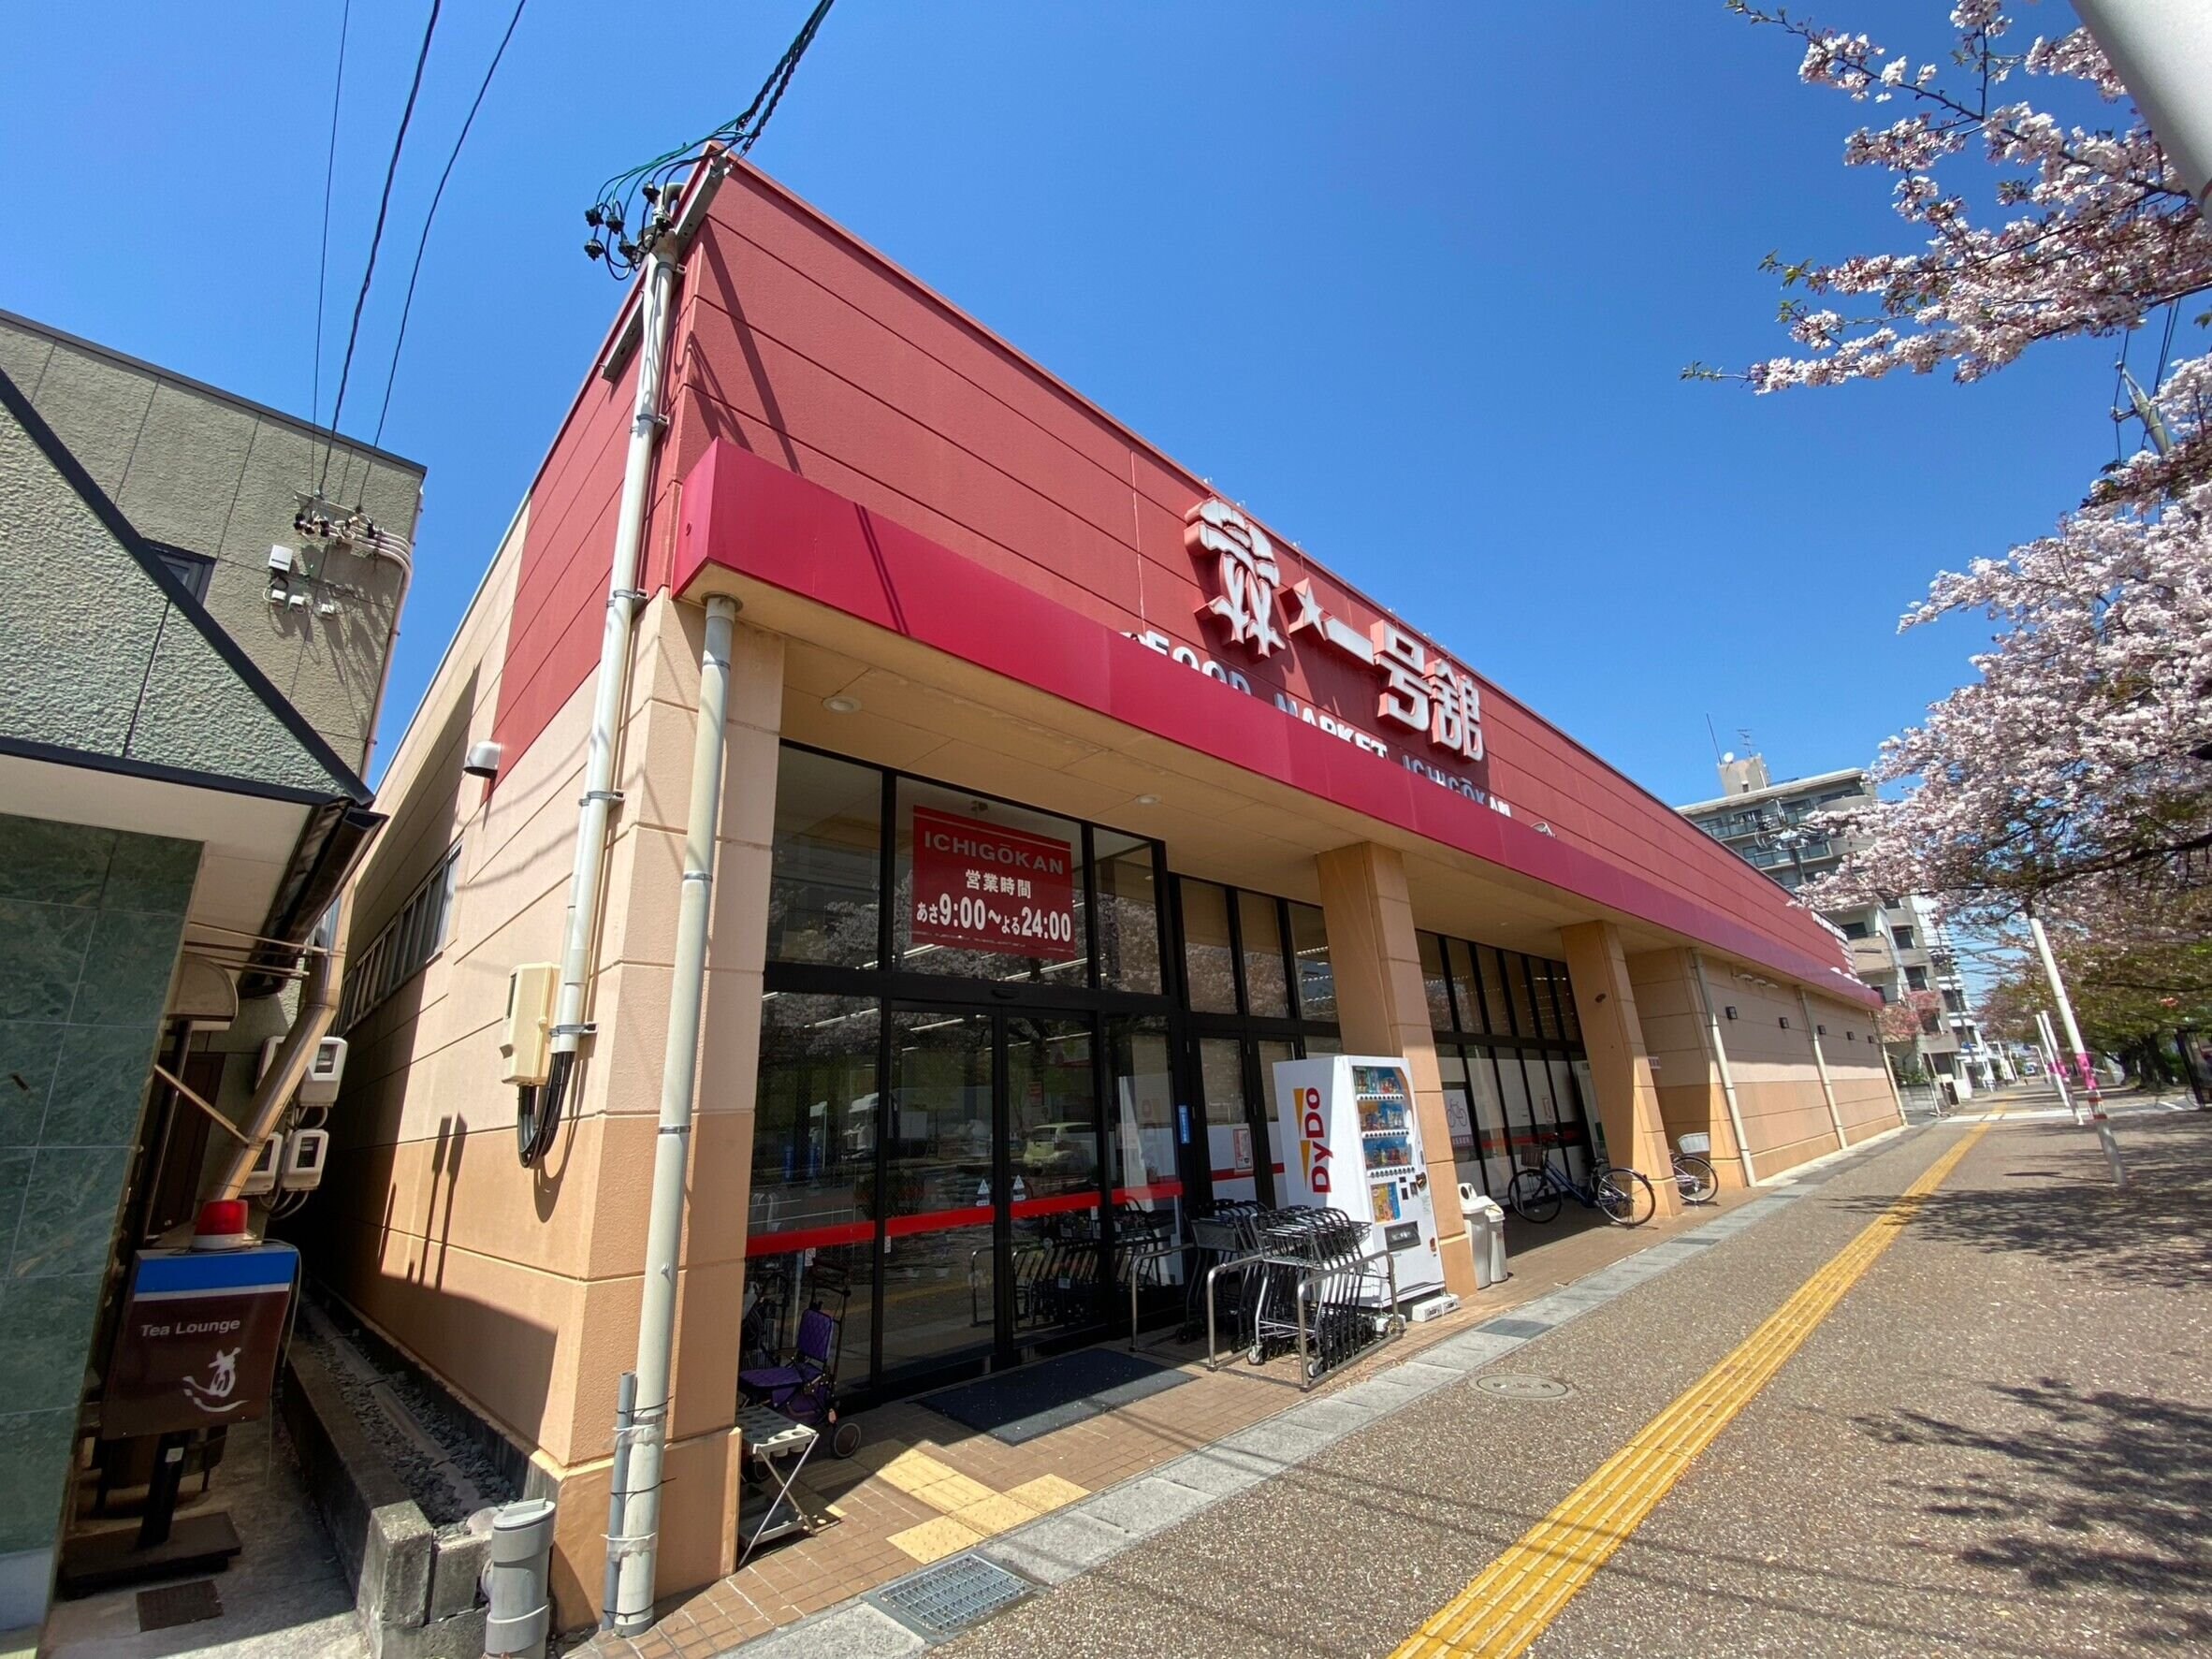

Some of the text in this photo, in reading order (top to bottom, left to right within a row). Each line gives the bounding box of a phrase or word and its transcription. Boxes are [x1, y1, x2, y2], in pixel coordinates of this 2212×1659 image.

[966, 869, 1031, 898] 営業時間
[140, 1317, 240, 1337] Tea Lounge
